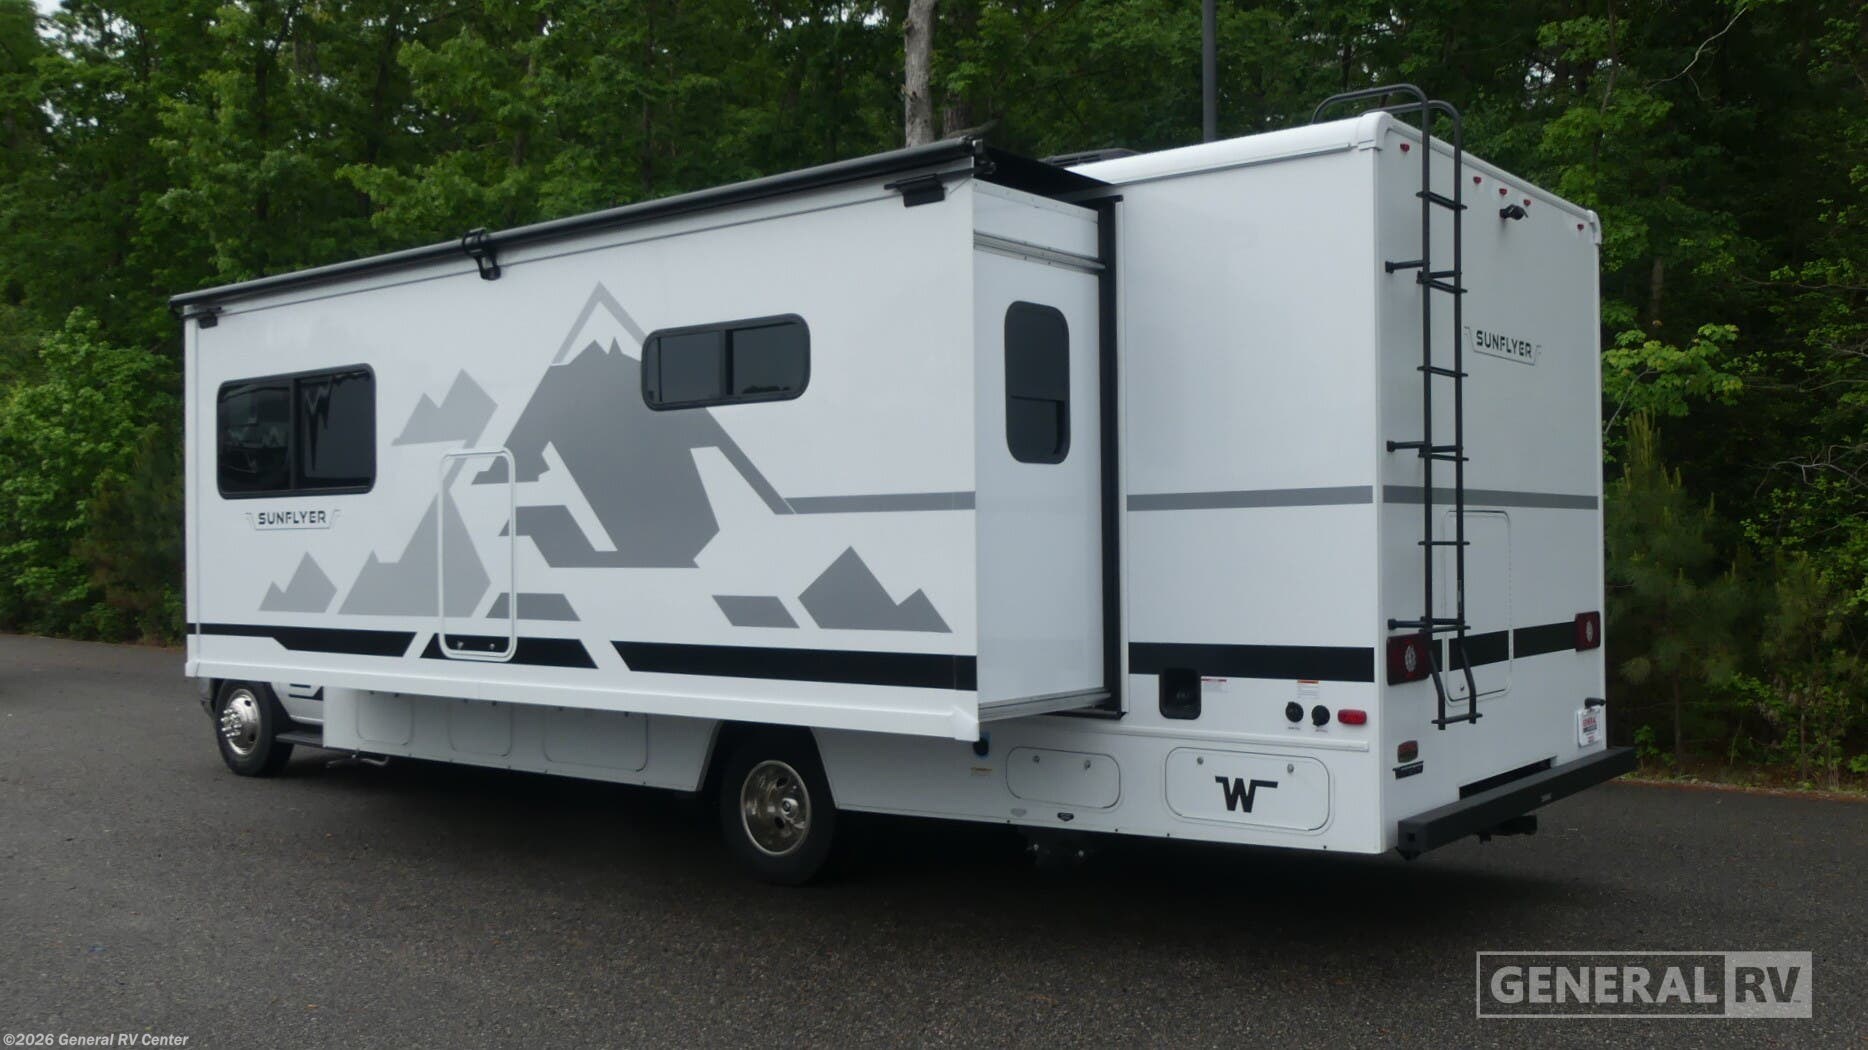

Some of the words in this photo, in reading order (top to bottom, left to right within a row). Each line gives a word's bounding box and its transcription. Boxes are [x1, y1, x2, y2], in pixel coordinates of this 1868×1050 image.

[1476, 330, 1532, 358] SUNFLYER
[258, 510, 326, 525] SUNFLYER
[1215, 776, 1278, 813] W
